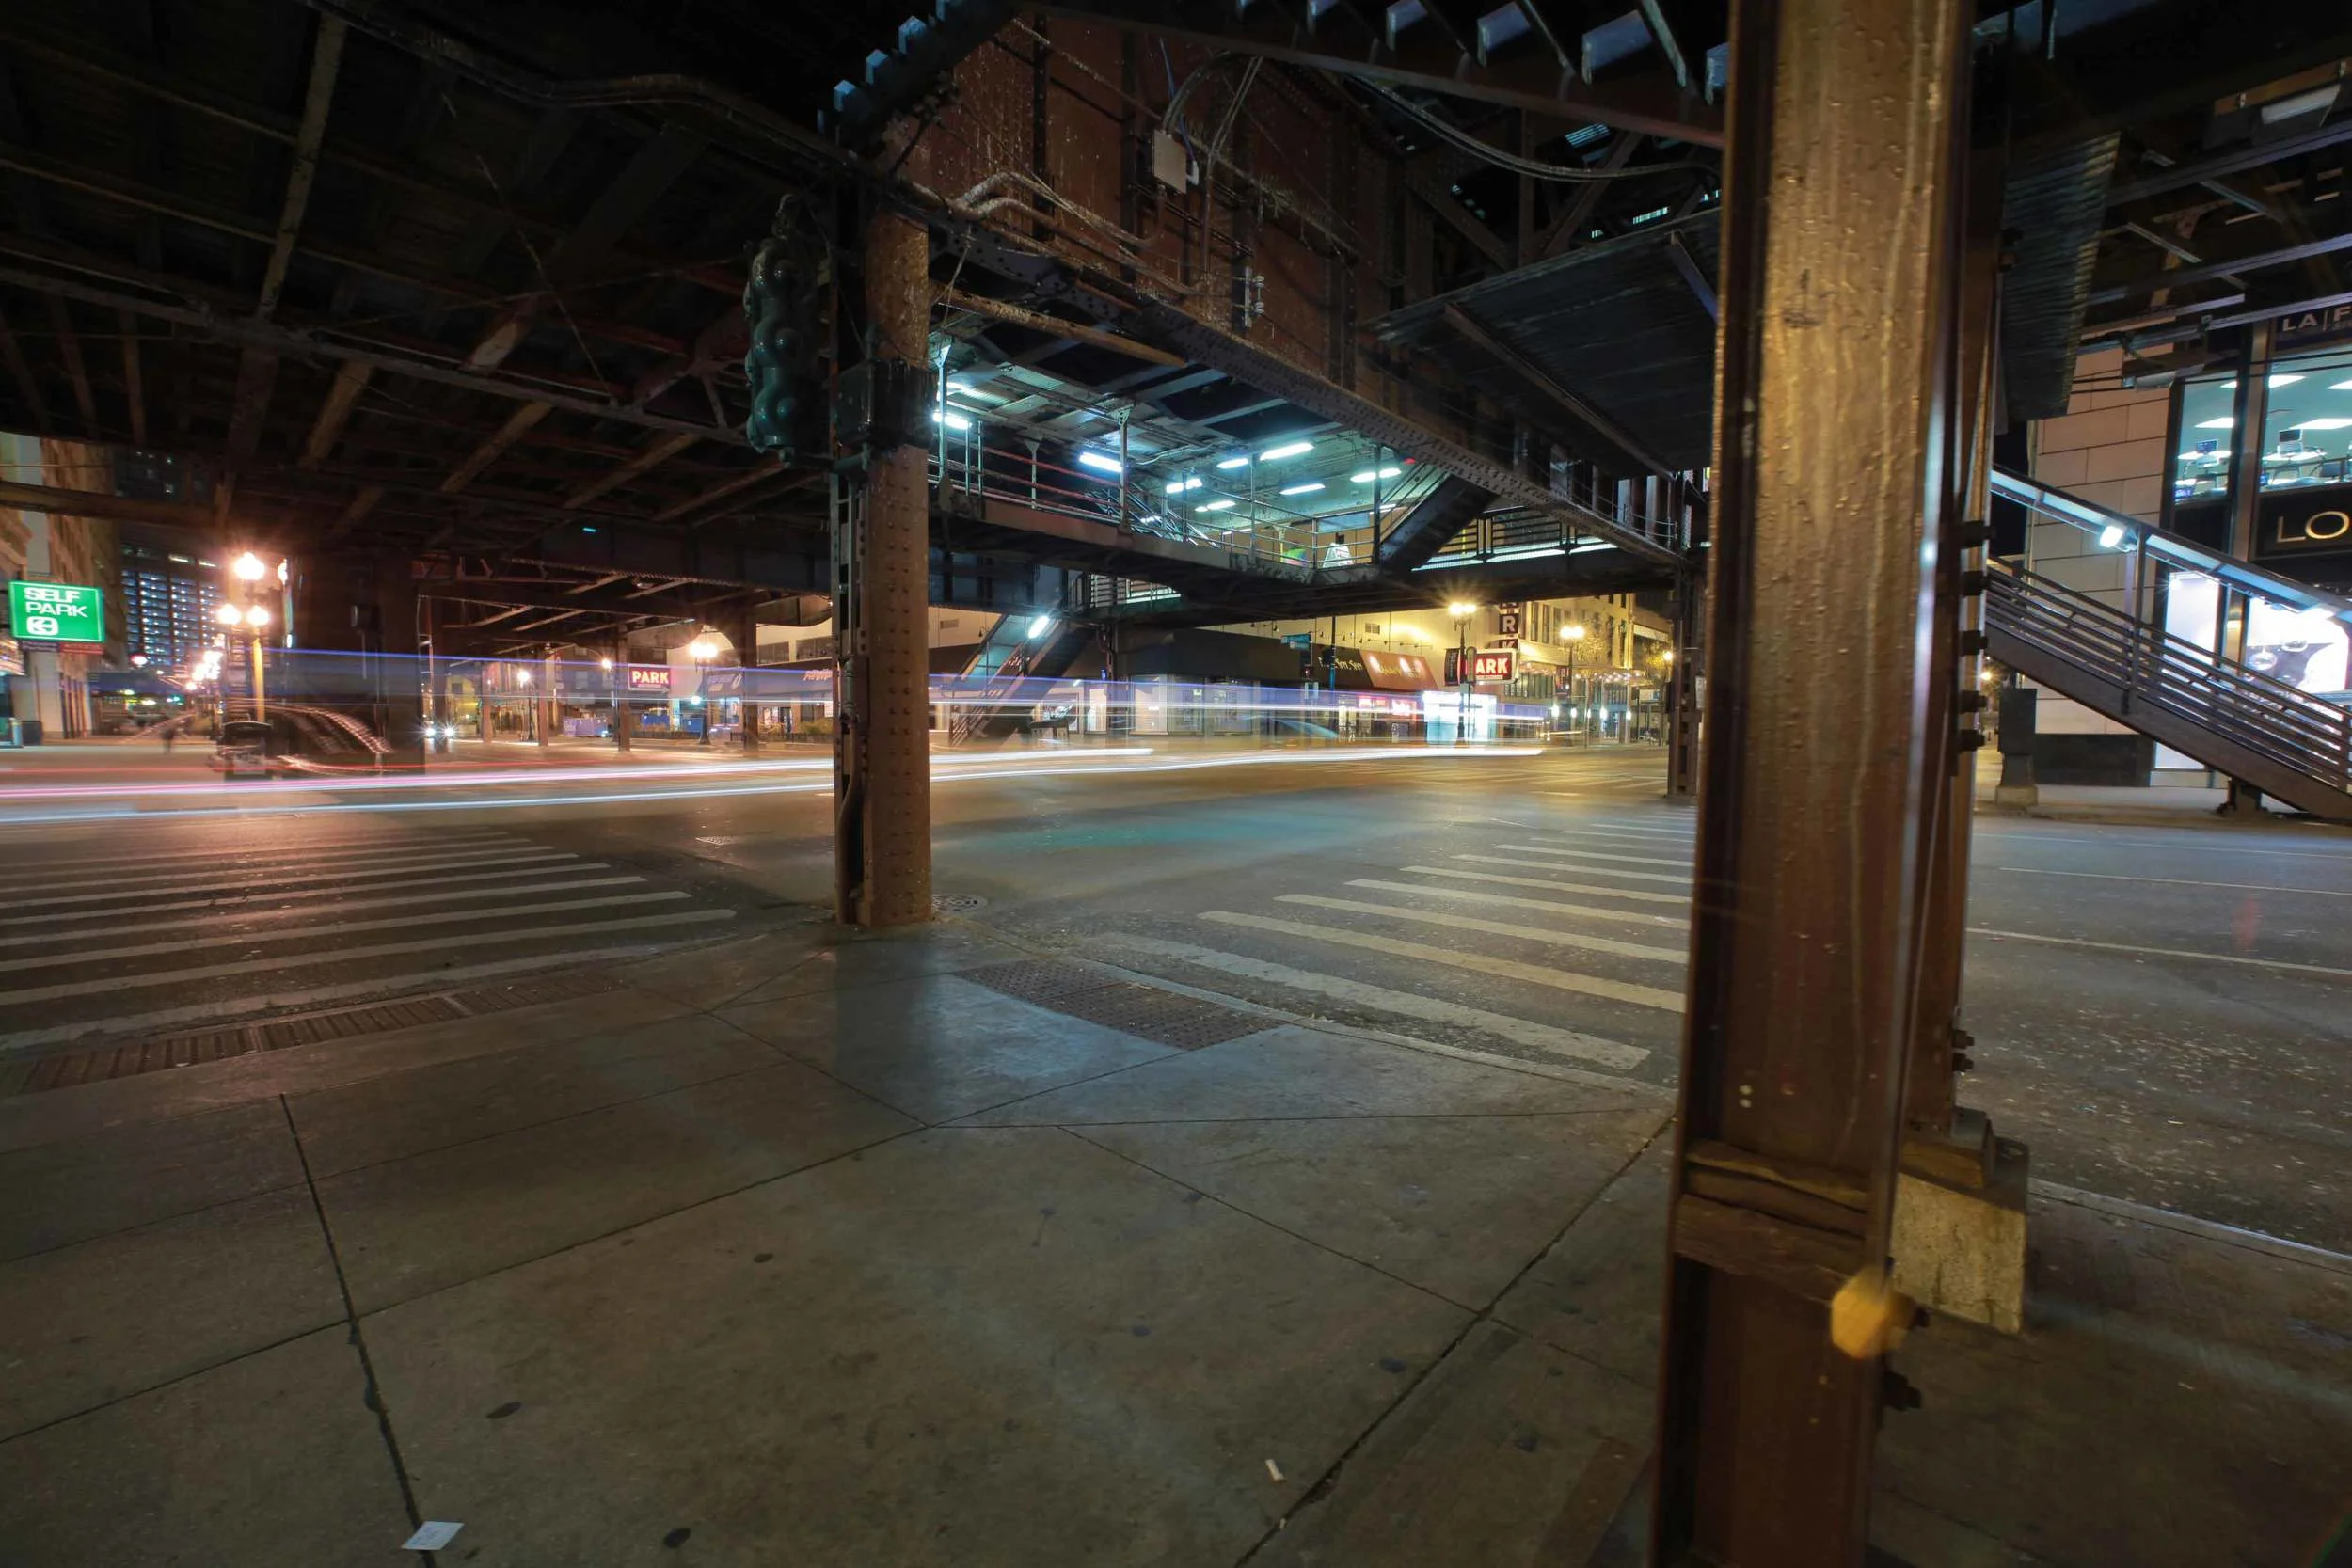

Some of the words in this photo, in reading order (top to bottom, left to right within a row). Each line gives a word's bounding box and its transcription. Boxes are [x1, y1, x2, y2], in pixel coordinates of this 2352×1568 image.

[2282, 312, 2318, 332] LA
[2277, 511, 2350, 543] LO
[24, 587, 81, 603] SELF
[24, 601, 89, 618] PARK
[1465, 657, 1508, 675] ARK
[631, 670, 669, 684] PARK
